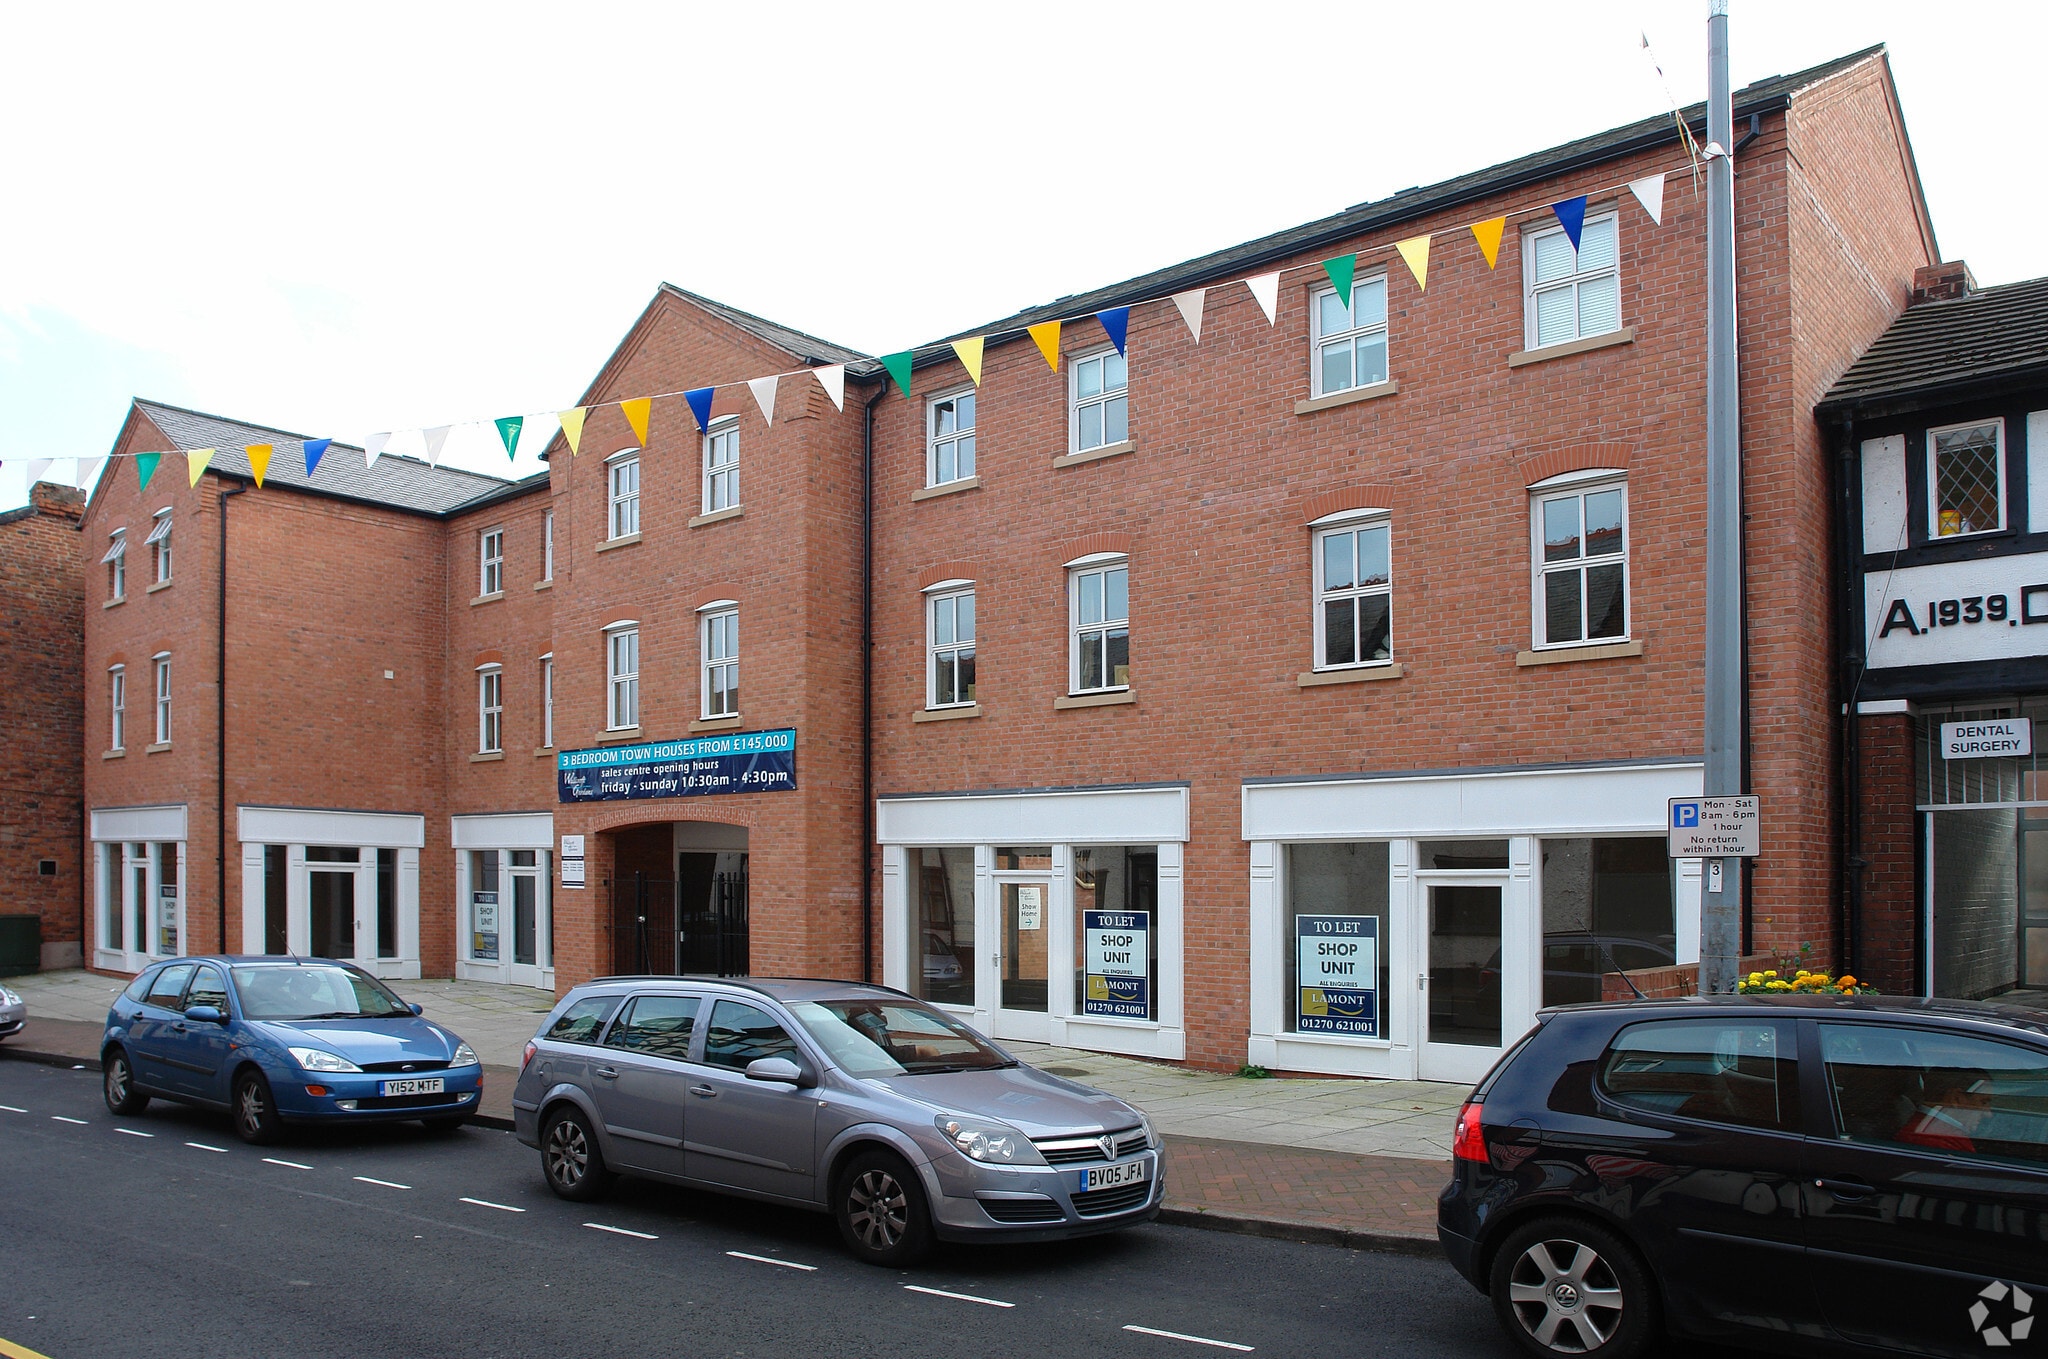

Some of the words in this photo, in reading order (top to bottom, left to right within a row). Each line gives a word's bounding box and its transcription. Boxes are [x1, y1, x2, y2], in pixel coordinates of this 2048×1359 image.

[1956, 725, 2014, 738] DENTAL
[563, 756, 568, 766] 3
[571, 751, 618, 765] BEDROOM
[621, 747, 651, 760] TOWN
[654, 743, 695, 758] HOUSES
[698, 740, 730, 754] FROM
[734, 734, 788, 750] £145,000
[1950, 740, 2020, 753] SURGERY
[601, 768, 622, 778] sales
[624, 766, 650, 776] centre
[653, 761, 689, 775] opening
[693, 761, 719, 771] hours
[601, 781, 630, 795] friday
[640, 778, 677, 792] sunday
[682, 775, 729, 788] 10:30am
[742, 771, 788, 785] 4:30pm
[1735, 800, 1752, 808] Sat
[1680, 806, 1695, 825] P
[1691, 836, 1704, 844] No
[1712, 865, 1720, 875] 3
[1098, 915, 1112, 926] TO
[1115, 916, 1135, 927] LET
[1314, 921, 1332, 933] TO
[1335, 922, 1360, 933] LET
[1101, 935, 1133, 947] SHOP
[1318, 942, 1358, 956] SHOP
[1104, 952, 1131, 963] UNIT
[1321, 962, 1355, 975] UNIT
[1096, 981, 1138, 991] LAMONT
[1312, 994, 1365, 1005] LAMONT
[1087, 1002, 1113, 1012] 01270
[1115, 1004, 1144, 1015] 621001
[1302, 1018, 1333, 1029] 01270
[1336, 1021, 1373, 1032] 621001
[1089, 1168, 1121, 1187] BV05
[1124, 1163, 1142, 1181] JFA
